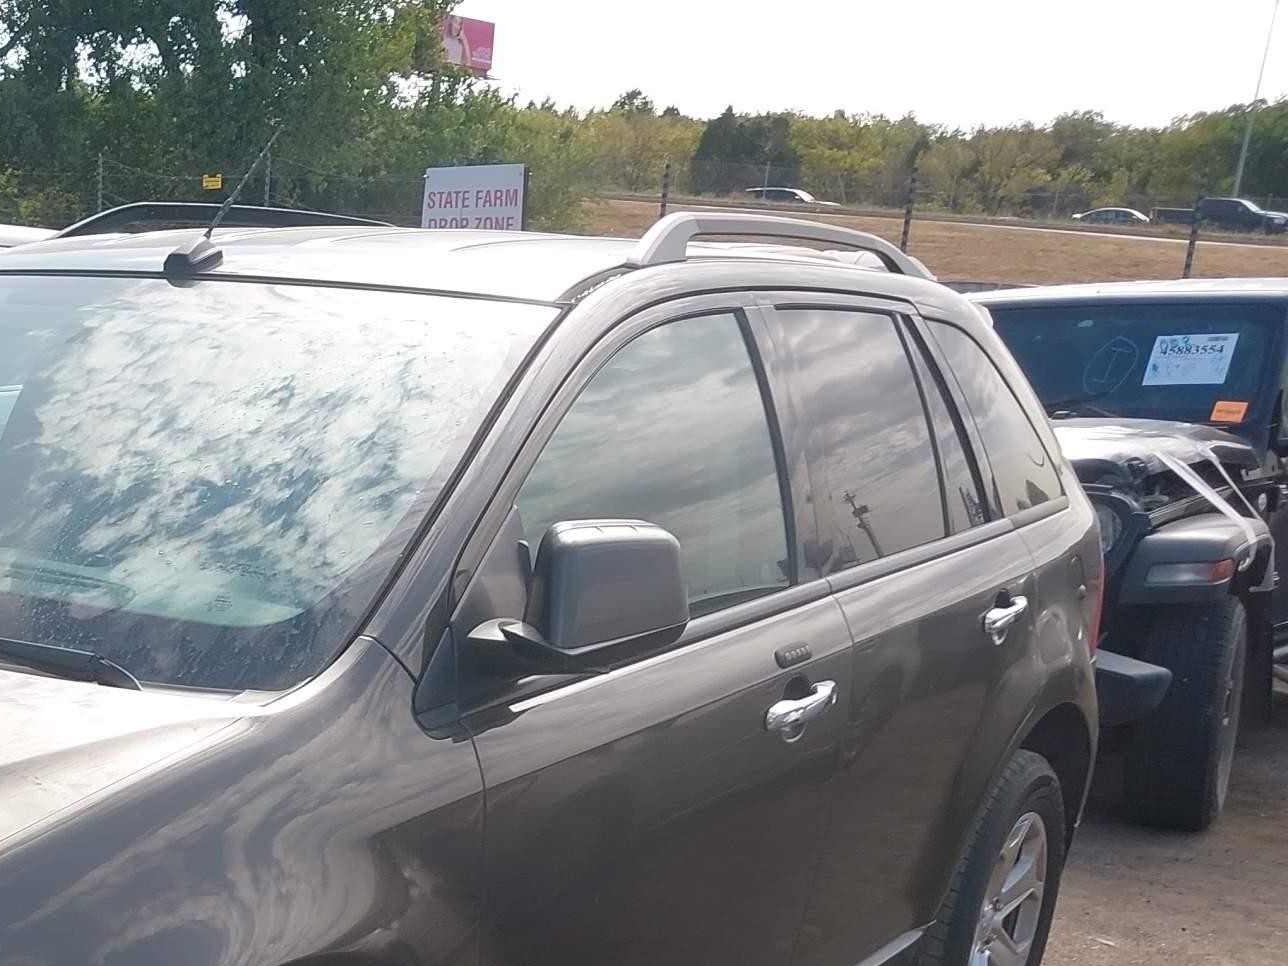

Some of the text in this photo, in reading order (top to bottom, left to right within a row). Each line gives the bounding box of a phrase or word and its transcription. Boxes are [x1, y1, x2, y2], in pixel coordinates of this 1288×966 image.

[427, 190, 518, 208] STATE FARM
[475, 216, 515, 230] ZONE
[1160, 344, 1224, 355] 45883554
